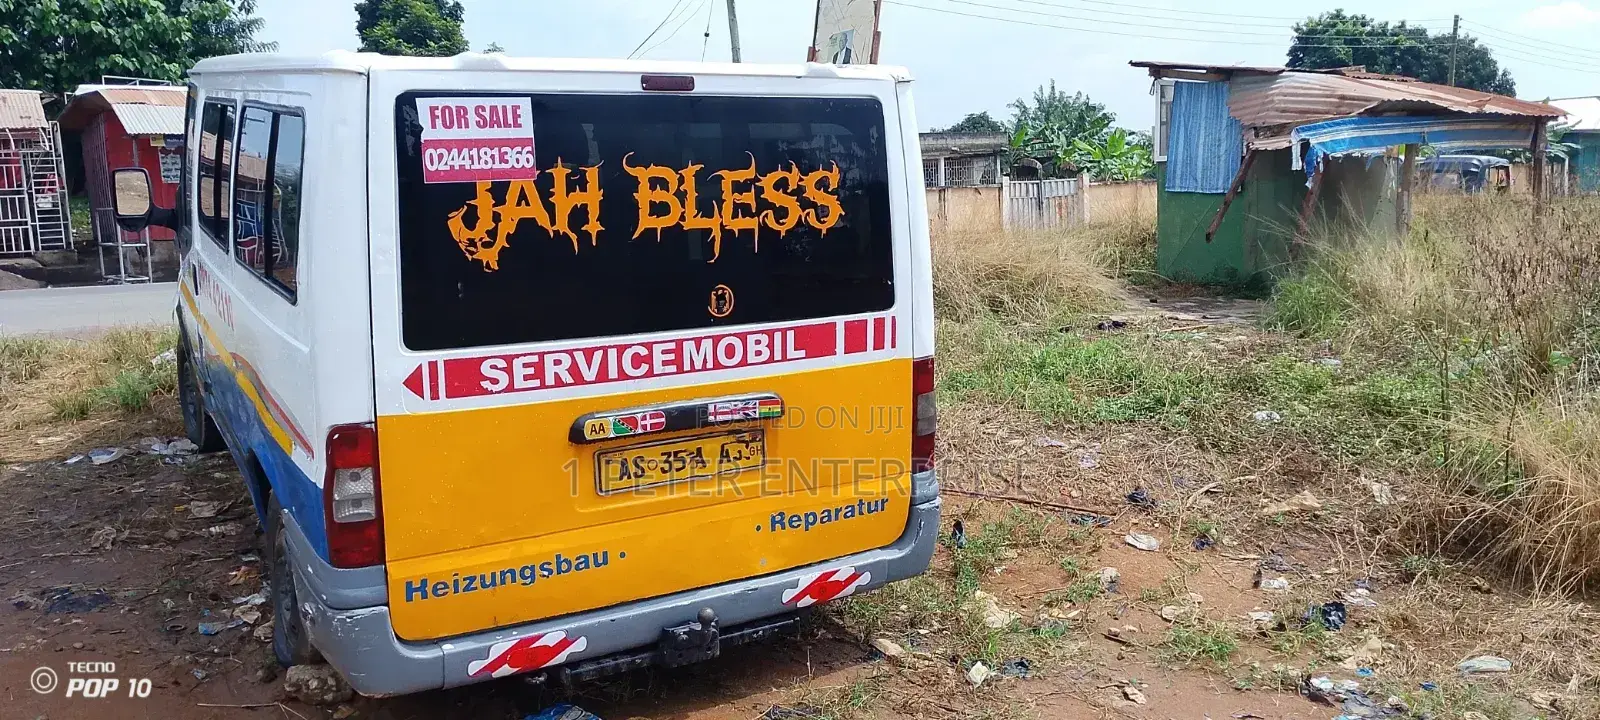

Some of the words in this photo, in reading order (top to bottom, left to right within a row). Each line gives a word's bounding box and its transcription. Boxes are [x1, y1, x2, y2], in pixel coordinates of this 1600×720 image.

[429, 105, 470, 129] FOR
[474, 104, 523, 129] SALE
[424, 146, 534, 172] 0244181366
[447, 156, 605, 273] JAH
[622, 150, 846, 264] BLESS
[590, 422, 606, 436] AA
[770, 497, 889, 532] Reparatur
[405, 550, 609, 603] Heizungsbau
